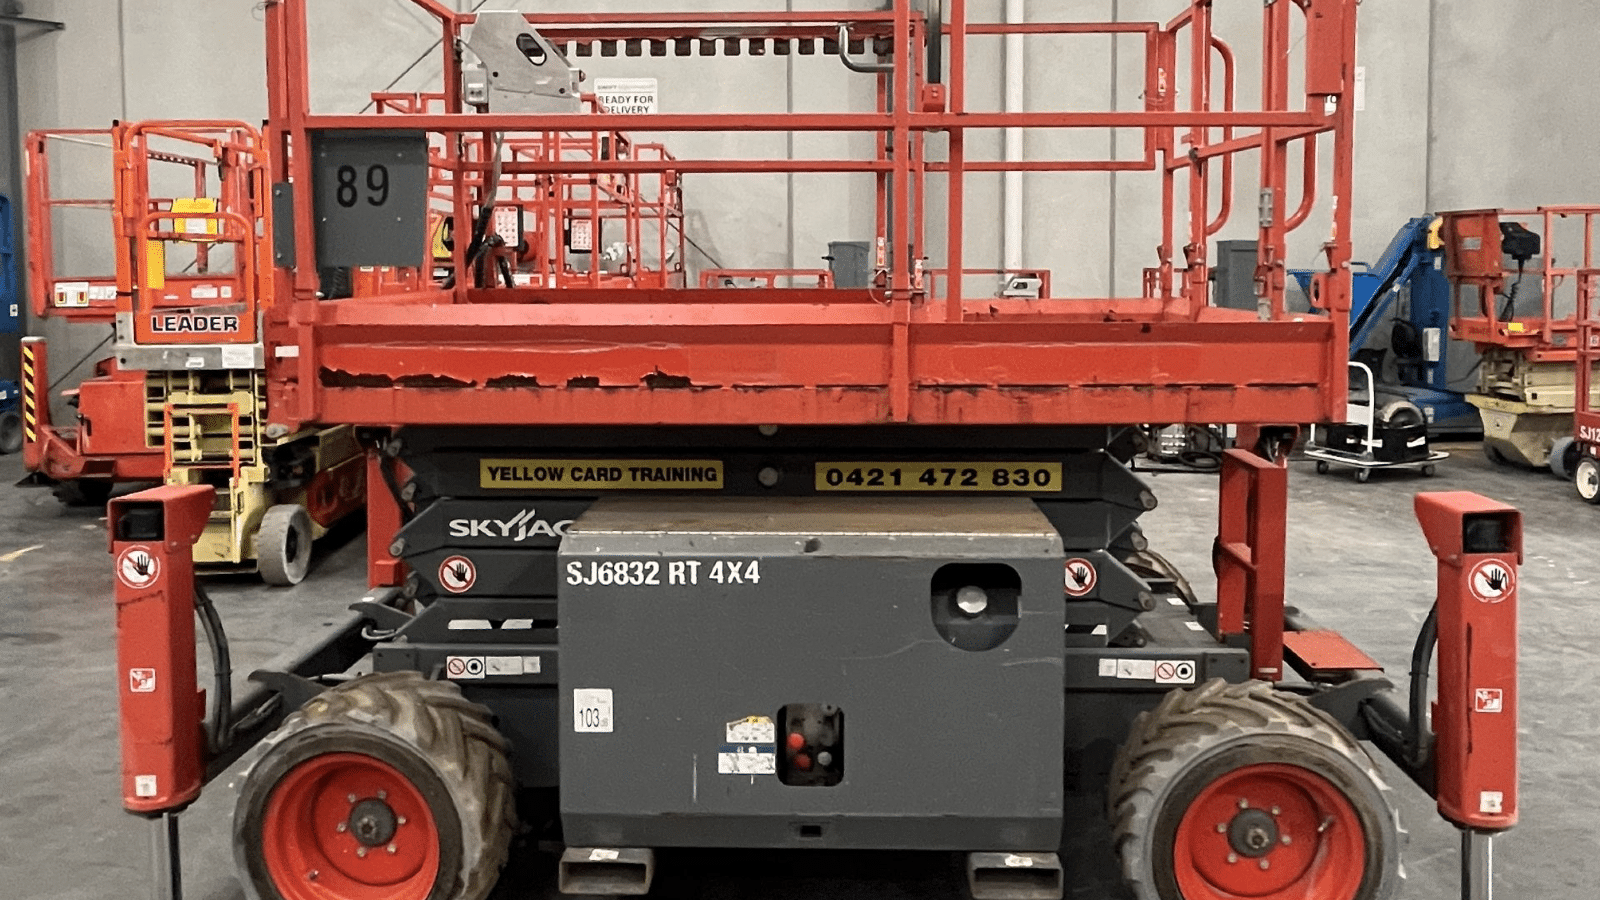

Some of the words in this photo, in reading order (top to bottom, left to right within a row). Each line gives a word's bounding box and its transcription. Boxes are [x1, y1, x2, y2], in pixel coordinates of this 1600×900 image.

[598, 95, 631, 104] READY
[634, 95, 654, 104] FOR
[337, 165, 389, 208] 89
[151, 315, 239, 332] LEADER
[487, 466, 565, 482] YELLOW
[570, 466, 622, 482] CARD
[627, 466, 718, 482] TRAINING
[825, 467, 902, 487] 0421
[918, 467, 979, 487] 472
[991, 468, 1051, 487] 830
[566, 560, 660, 586] SJ6832
[668, 561, 701, 585] RT
[708, 560, 760, 584] 4X4
[579, 707, 600, 728] 103
